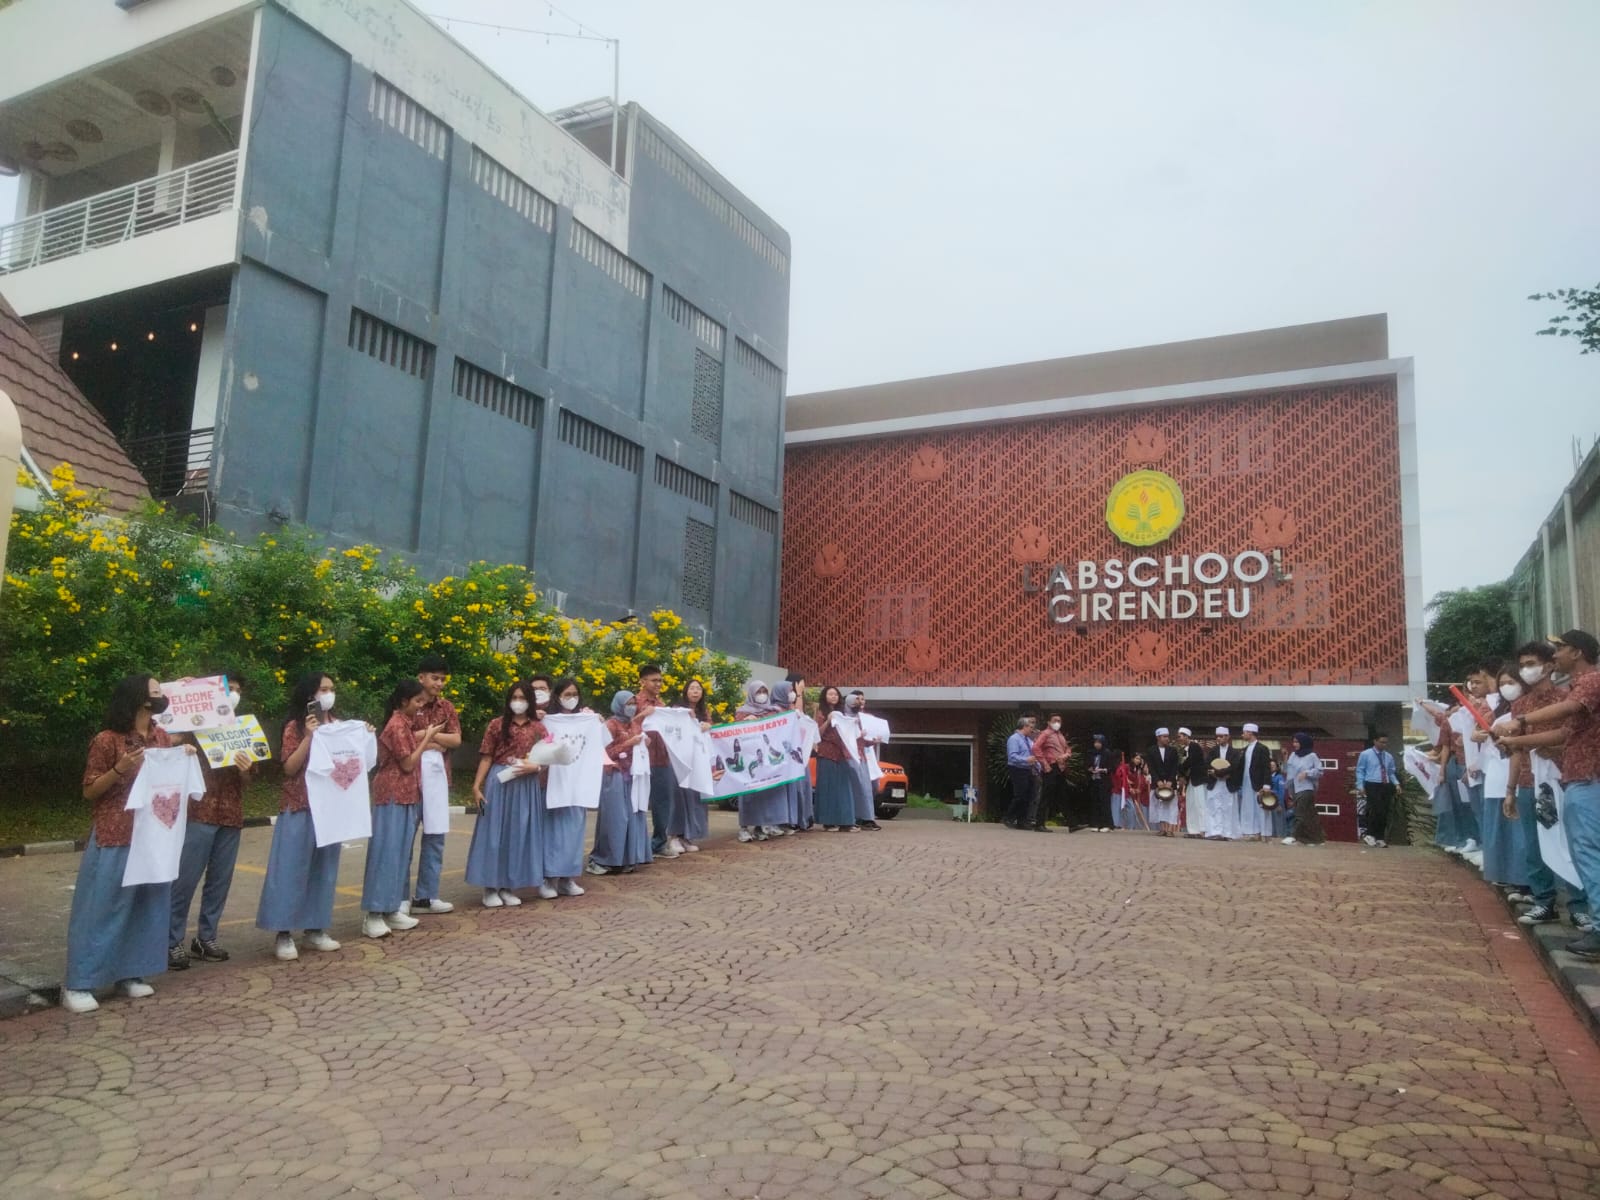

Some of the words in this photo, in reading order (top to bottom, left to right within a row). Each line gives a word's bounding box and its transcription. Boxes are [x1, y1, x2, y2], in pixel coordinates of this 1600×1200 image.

[1023, 549, 1293, 592] LABSCHOOL
[1049, 587, 1251, 624] CIRENDEU
[172, 702, 214, 715] PUTERI
[208, 728, 253, 742] WELCOME
[222, 738, 252, 752] YUSUF
